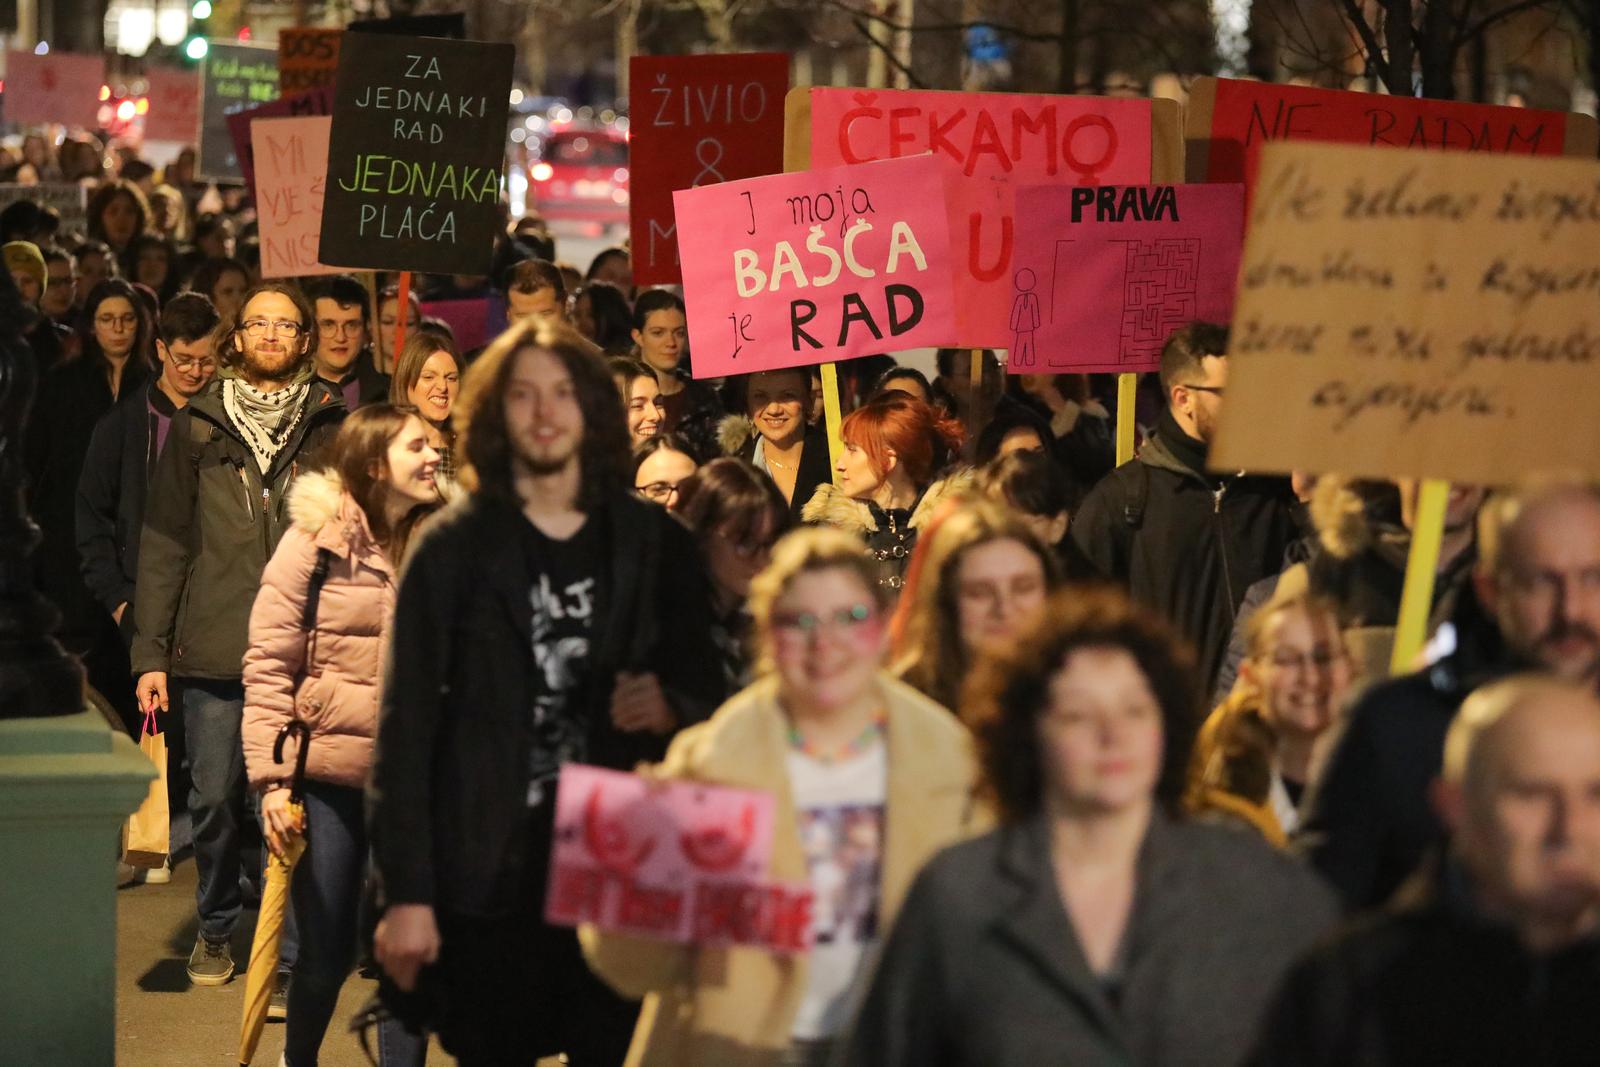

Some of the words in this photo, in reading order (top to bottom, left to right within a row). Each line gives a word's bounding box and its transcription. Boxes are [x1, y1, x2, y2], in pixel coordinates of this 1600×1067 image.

[405, 55, 442, 80] ZA
[356, 87, 486, 118] JEDNAKI
[651, 73, 766, 126] ŽIVIO
[265, 134, 308, 176] MI
[394, 118, 443, 144] RAD
[838, 92, 1118, 178] ČEKAMO
[339, 154, 498, 204] JEDNAKA
[692, 138, 725, 187] 8
[360, 202, 456, 243] PLAĆA
[786, 185, 875, 239] moja
[1071, 186, 1180, 223] PRAVA
[733, 218, 928, 298] BAŠČA
[968, 212, 1013, 282] U
[728, 312, 756, 358] je
[790, 283, 925, 351] RAD
